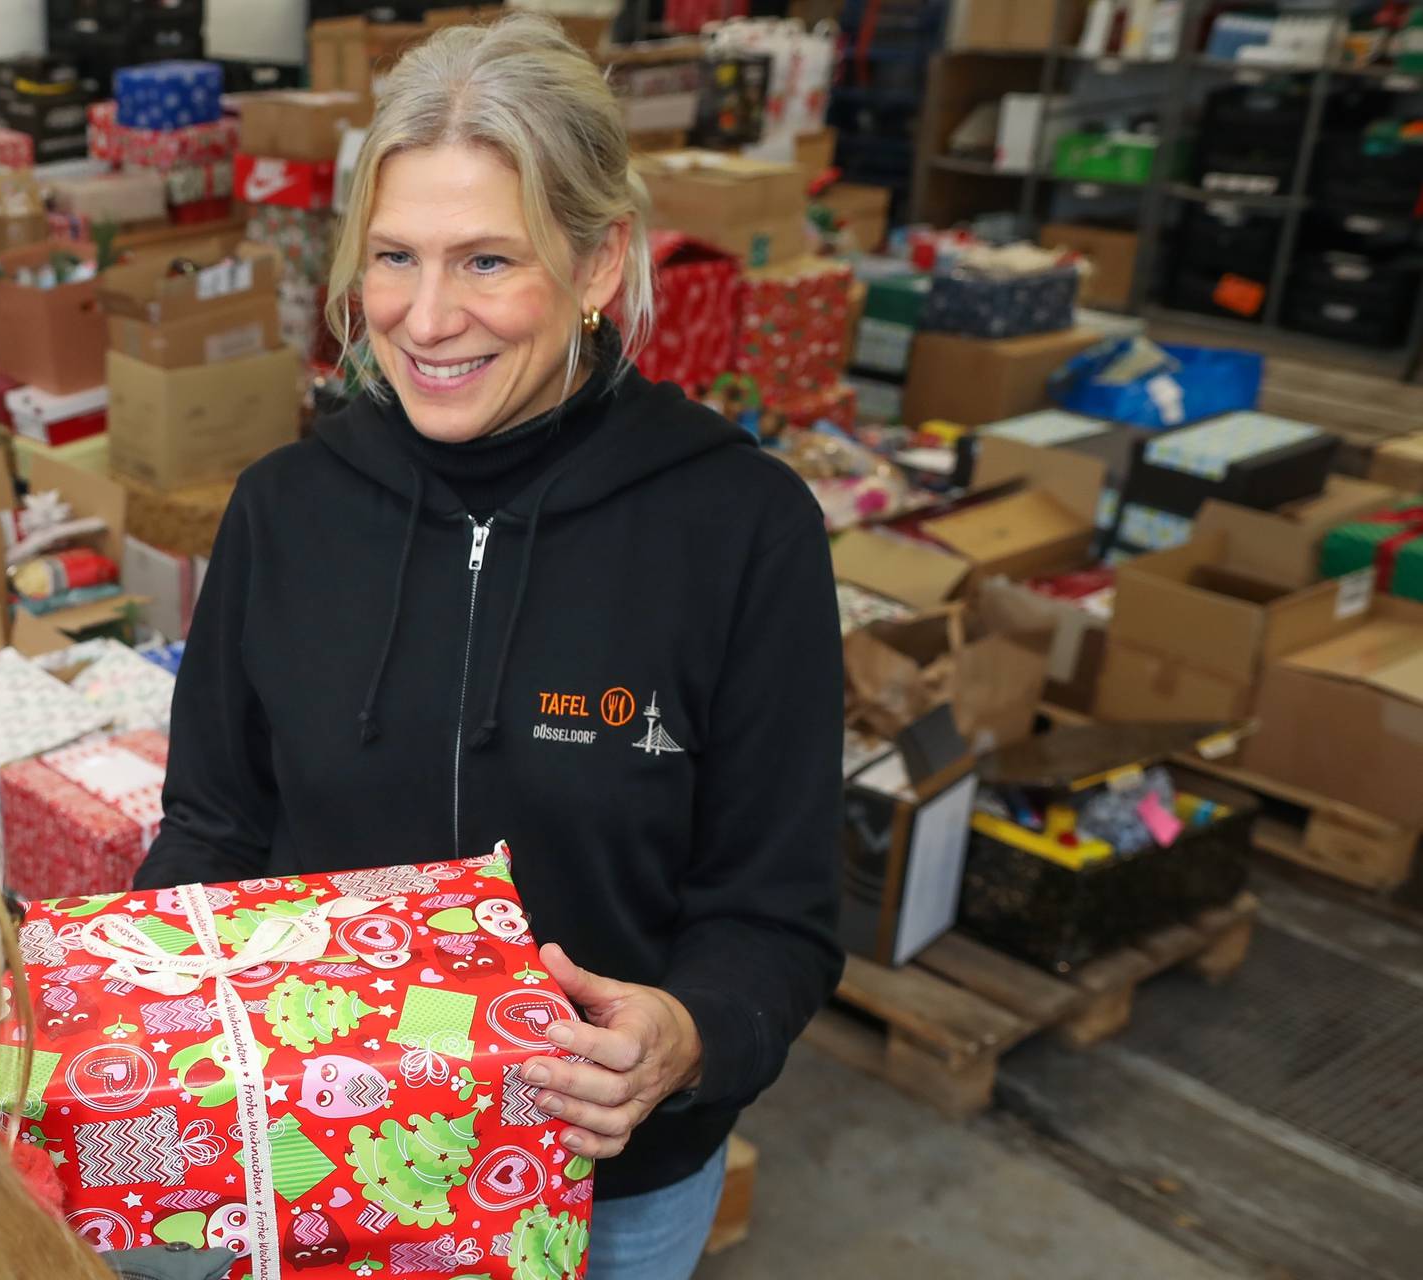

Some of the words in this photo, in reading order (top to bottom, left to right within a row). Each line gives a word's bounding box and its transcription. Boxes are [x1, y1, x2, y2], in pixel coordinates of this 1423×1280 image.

[539, 692, 589, 717] TAFEL
[533, 723, 597, 744] DÜSSELDORF
[226, 1004, 248, 1065] Weihnachten
[243, 1084, 258, 1118] Frohe
[248, 1120, 263, 1196] Weihnachten
[255, 1211, 268, 1241] Frohe
